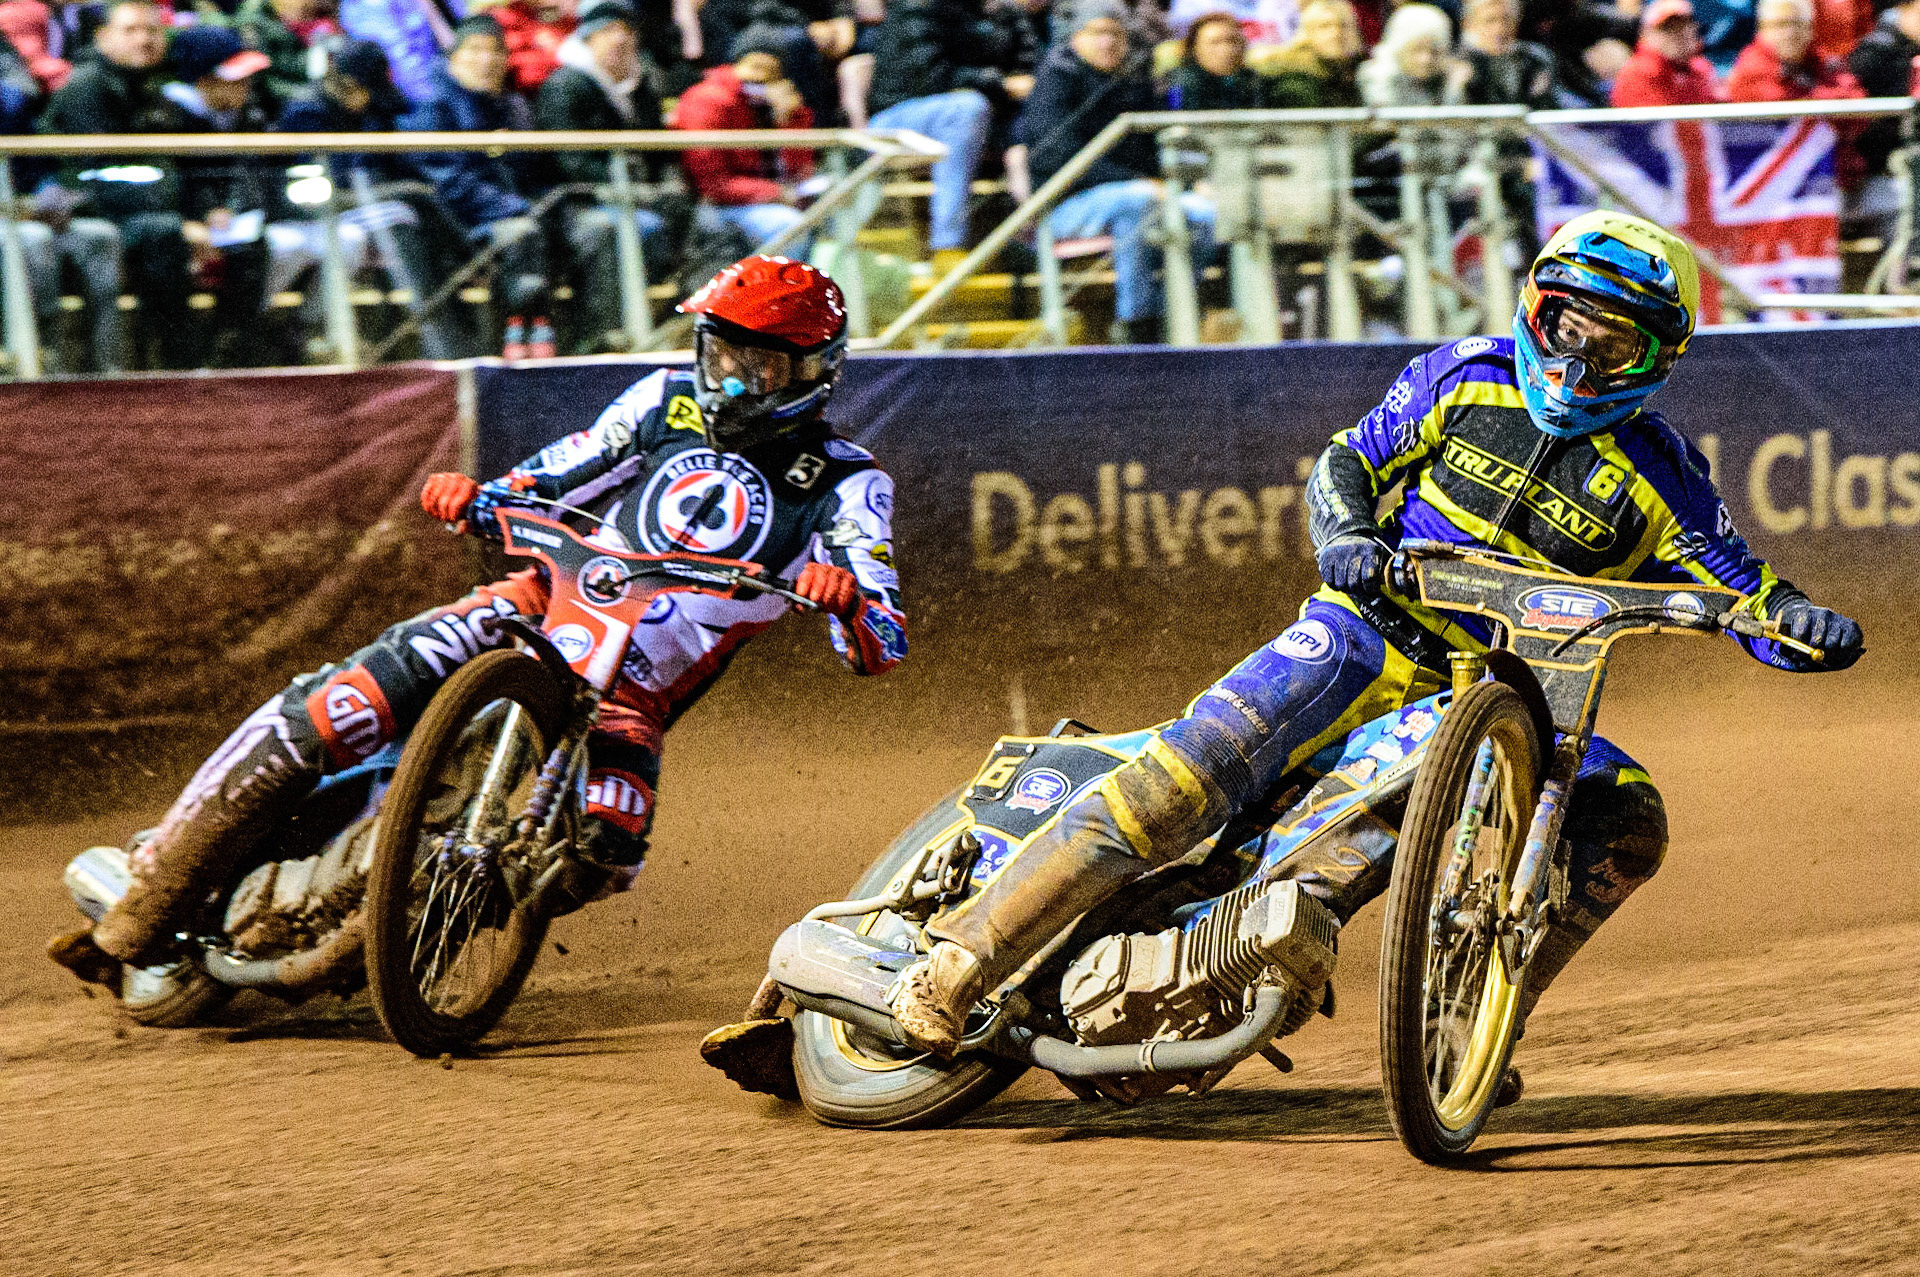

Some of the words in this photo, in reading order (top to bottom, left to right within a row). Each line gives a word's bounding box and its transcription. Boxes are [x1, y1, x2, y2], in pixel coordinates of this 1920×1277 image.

[665, 453, 717, 480] BELLE
[1586, 463, 1625, 501] 6
[1446, 441, 1503, 481] TRU
[1499, 471, 1607, 543] PLANT
[971, 457, 1314, 574] Deliveri
[1541, 594, 1598, 617] STE
[1286, 631, 1322, 652] ATPI
[976, 755, 1026, 789] 6
